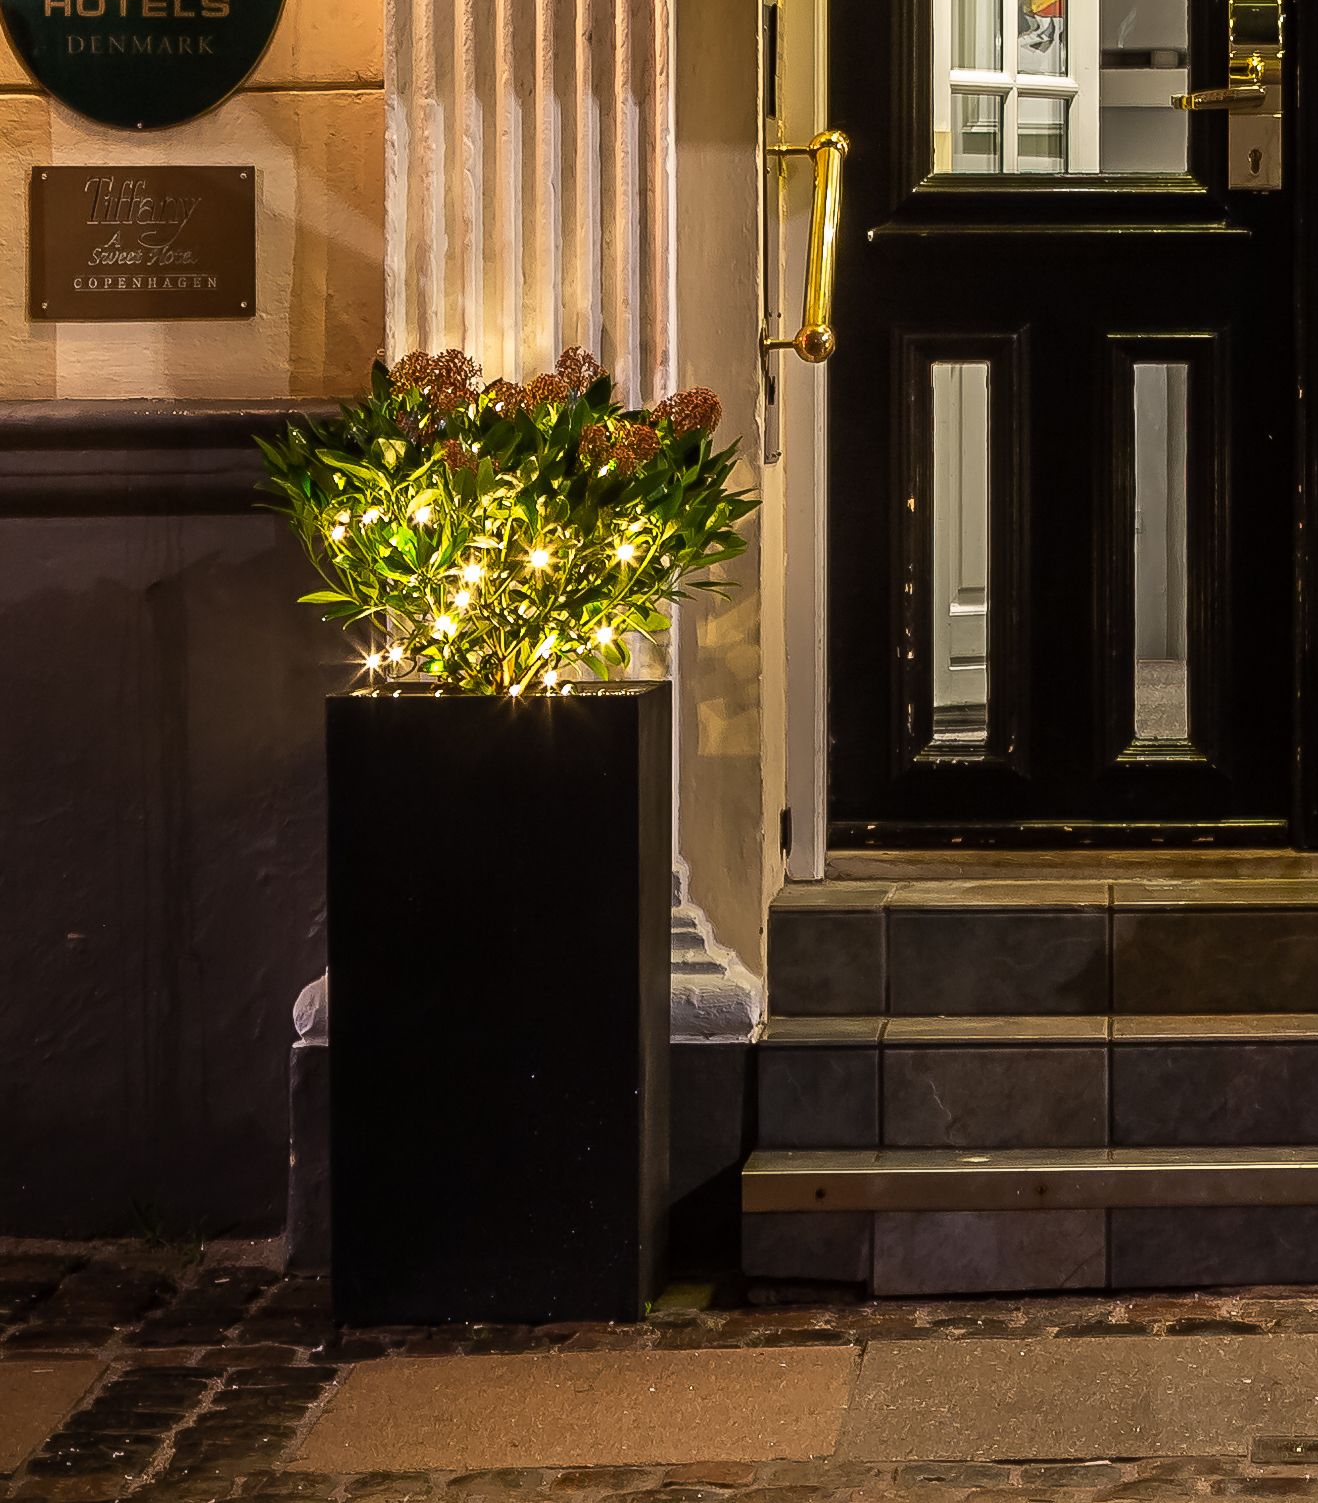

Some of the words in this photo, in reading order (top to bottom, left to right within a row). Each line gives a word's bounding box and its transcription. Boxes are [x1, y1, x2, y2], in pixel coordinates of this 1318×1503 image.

[67, 35, 214, 55] DENMARK
[84, 176, 200, 248] Tiffany
[104, 230, 121, 247] A
[88, 248, 143, 265] Sweet
[73, 277, 218, 288] COPENHAGEN
